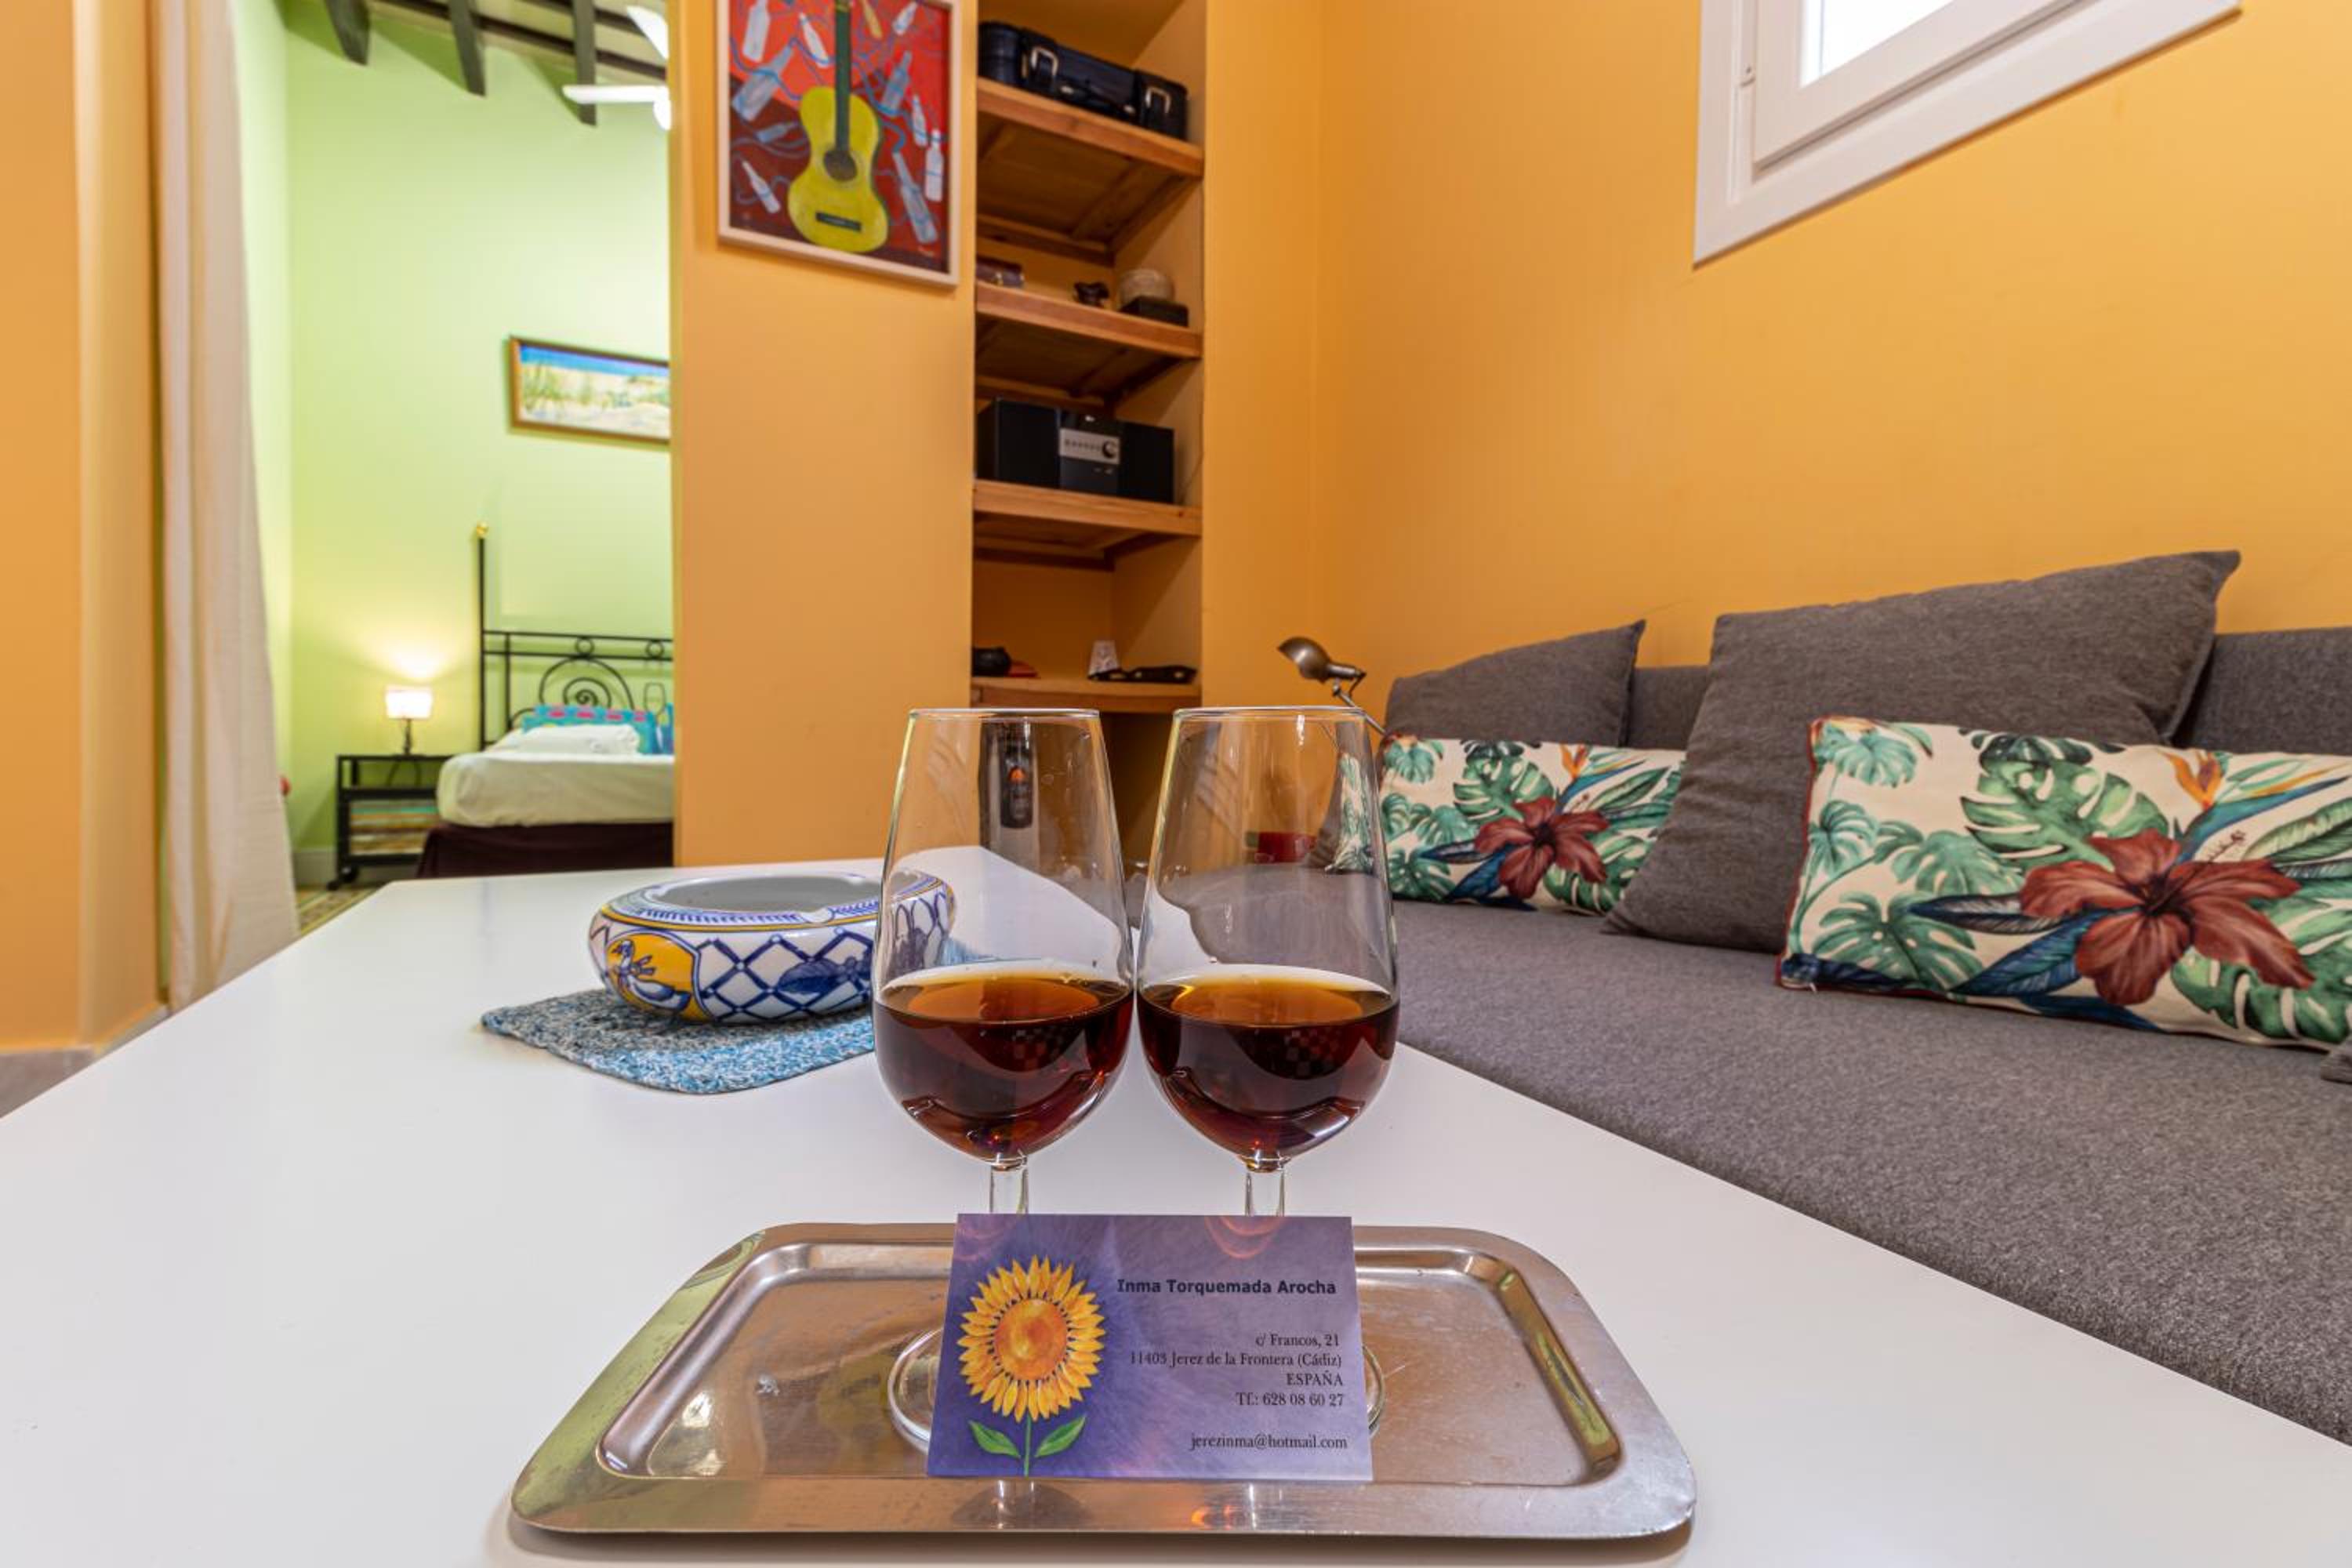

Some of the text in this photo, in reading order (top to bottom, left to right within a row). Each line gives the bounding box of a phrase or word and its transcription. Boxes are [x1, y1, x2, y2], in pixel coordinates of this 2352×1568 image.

[1117, 1279, 1337, 1295] Inma Torquemada Arocha
[1270, 1334, 1322, 1348] Francos,
[1324, 1334, 1339, 1346] 21
[1169, 1351, 1203, 1368] Jerez
[1207, 1350, 1222, 1364] de
[1225, 1351, 1236, 1365] la
[1240, 1352, 1294, 1365] Frontera
[1298, 1353, 1342, 1368] (Cádiz)
[1287, 1370, 1343, 1386] ESPAÑA
[1263, 1393, 1287, 1406] 628
[1290, 1394, 1305, 1406] 08
[1309, 1394, 1325, 1406] 60
[1329, 1394, 1344, 1406] 27
[1190, 1433, 1348, 1450] jerezinma@hotmail.com
